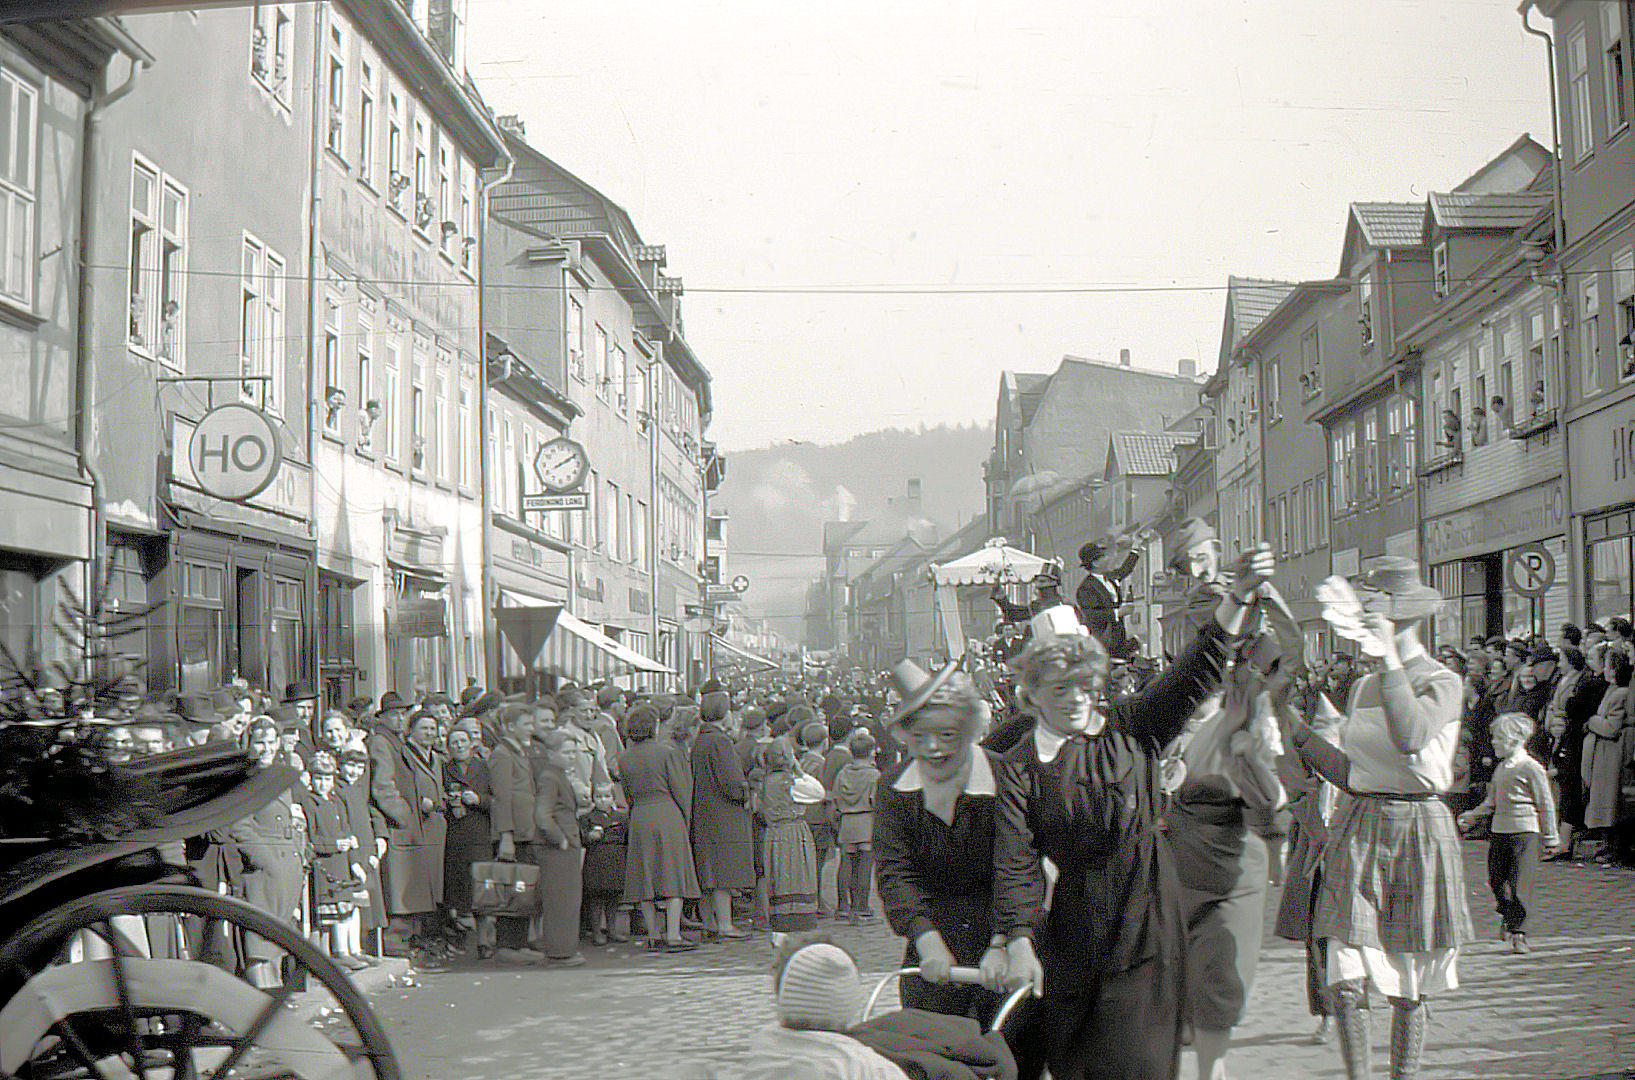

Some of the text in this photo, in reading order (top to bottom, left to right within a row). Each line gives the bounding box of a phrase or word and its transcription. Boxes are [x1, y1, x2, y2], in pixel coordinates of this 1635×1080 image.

[199, 434, 267, 472] HO
[526, 498, 563, 506] FERDINAND
[1543, 486, 1563, 529] HO
[1527, 555, 1542, 588] P
